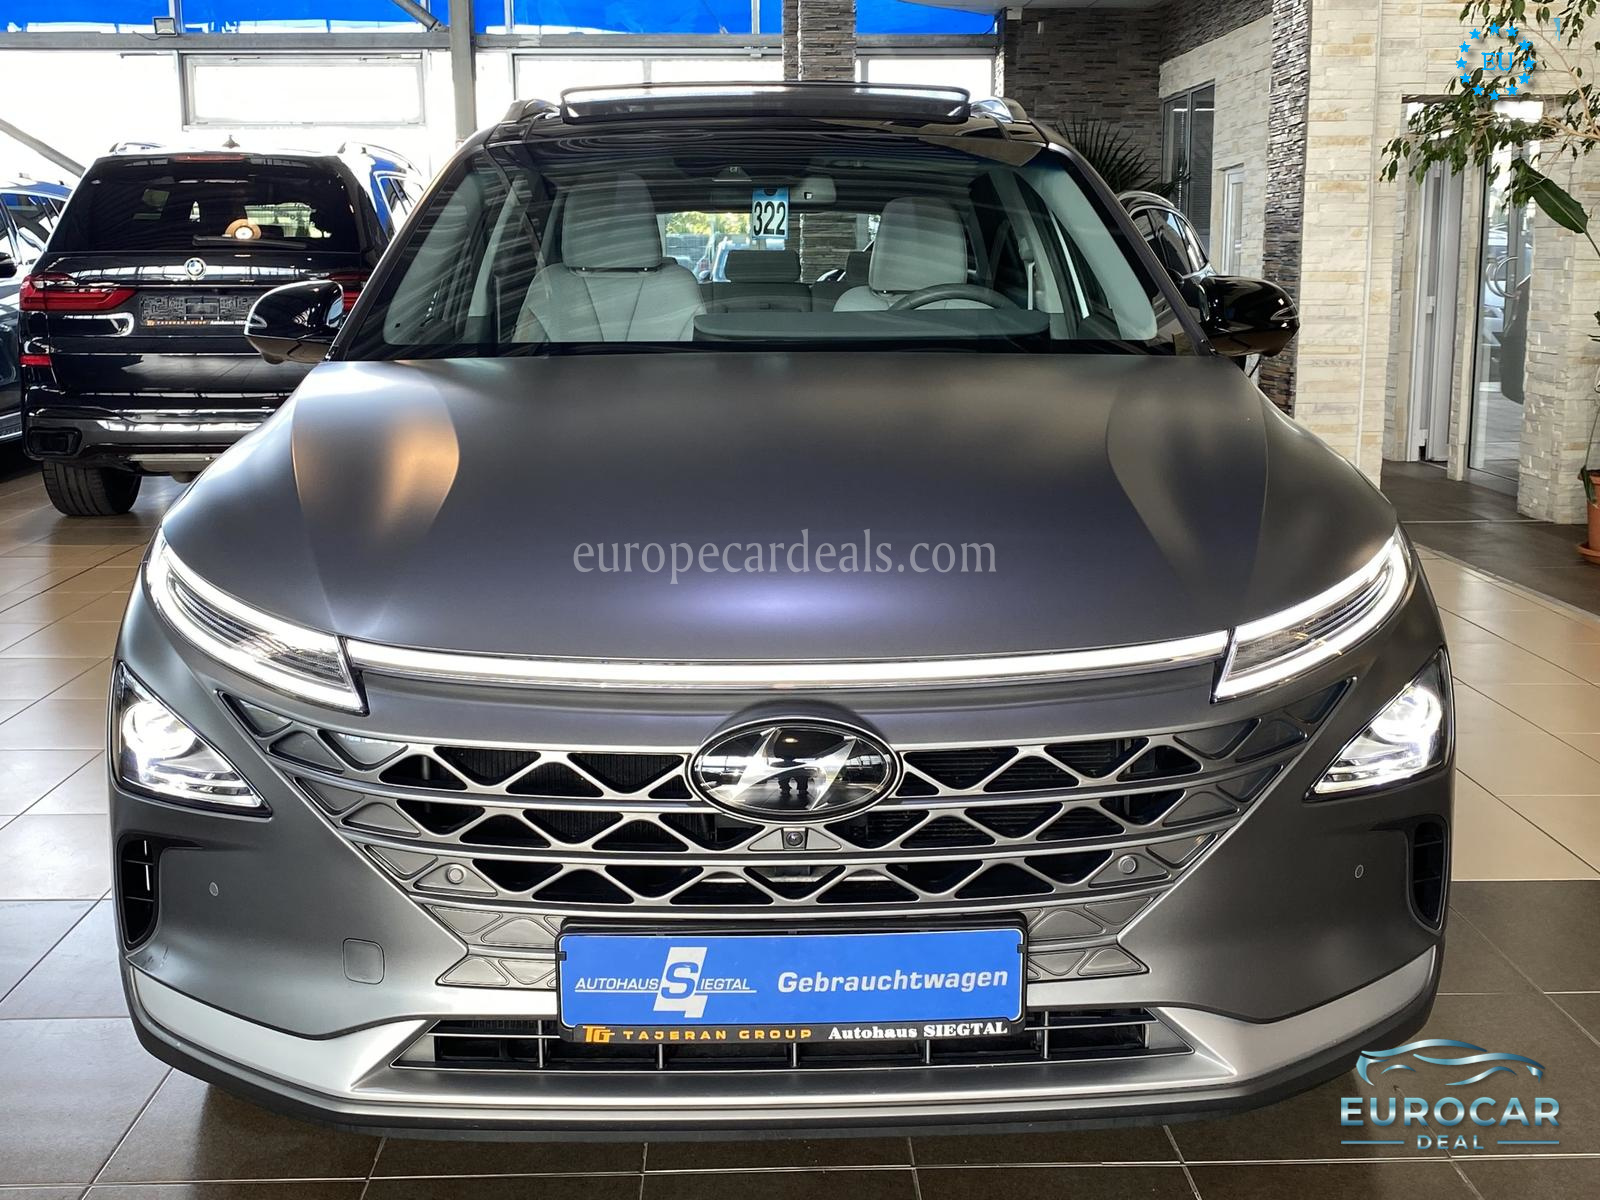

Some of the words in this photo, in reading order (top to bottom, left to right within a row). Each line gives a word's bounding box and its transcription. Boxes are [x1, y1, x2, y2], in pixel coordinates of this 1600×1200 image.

[754, 201, 786, 236] 322
[575, 977, 660, 990] AUTOHAUS
[777, 969, 1009, 993] Gebrauchtwagen
[622, 1030, 727, 1041] TAJERAN
[738, 1028, 812, 1041] GROUP
[828, 1026, 918, 1041] Autohaus
[923, 1021, 1008, 1038] SIEGTAL
